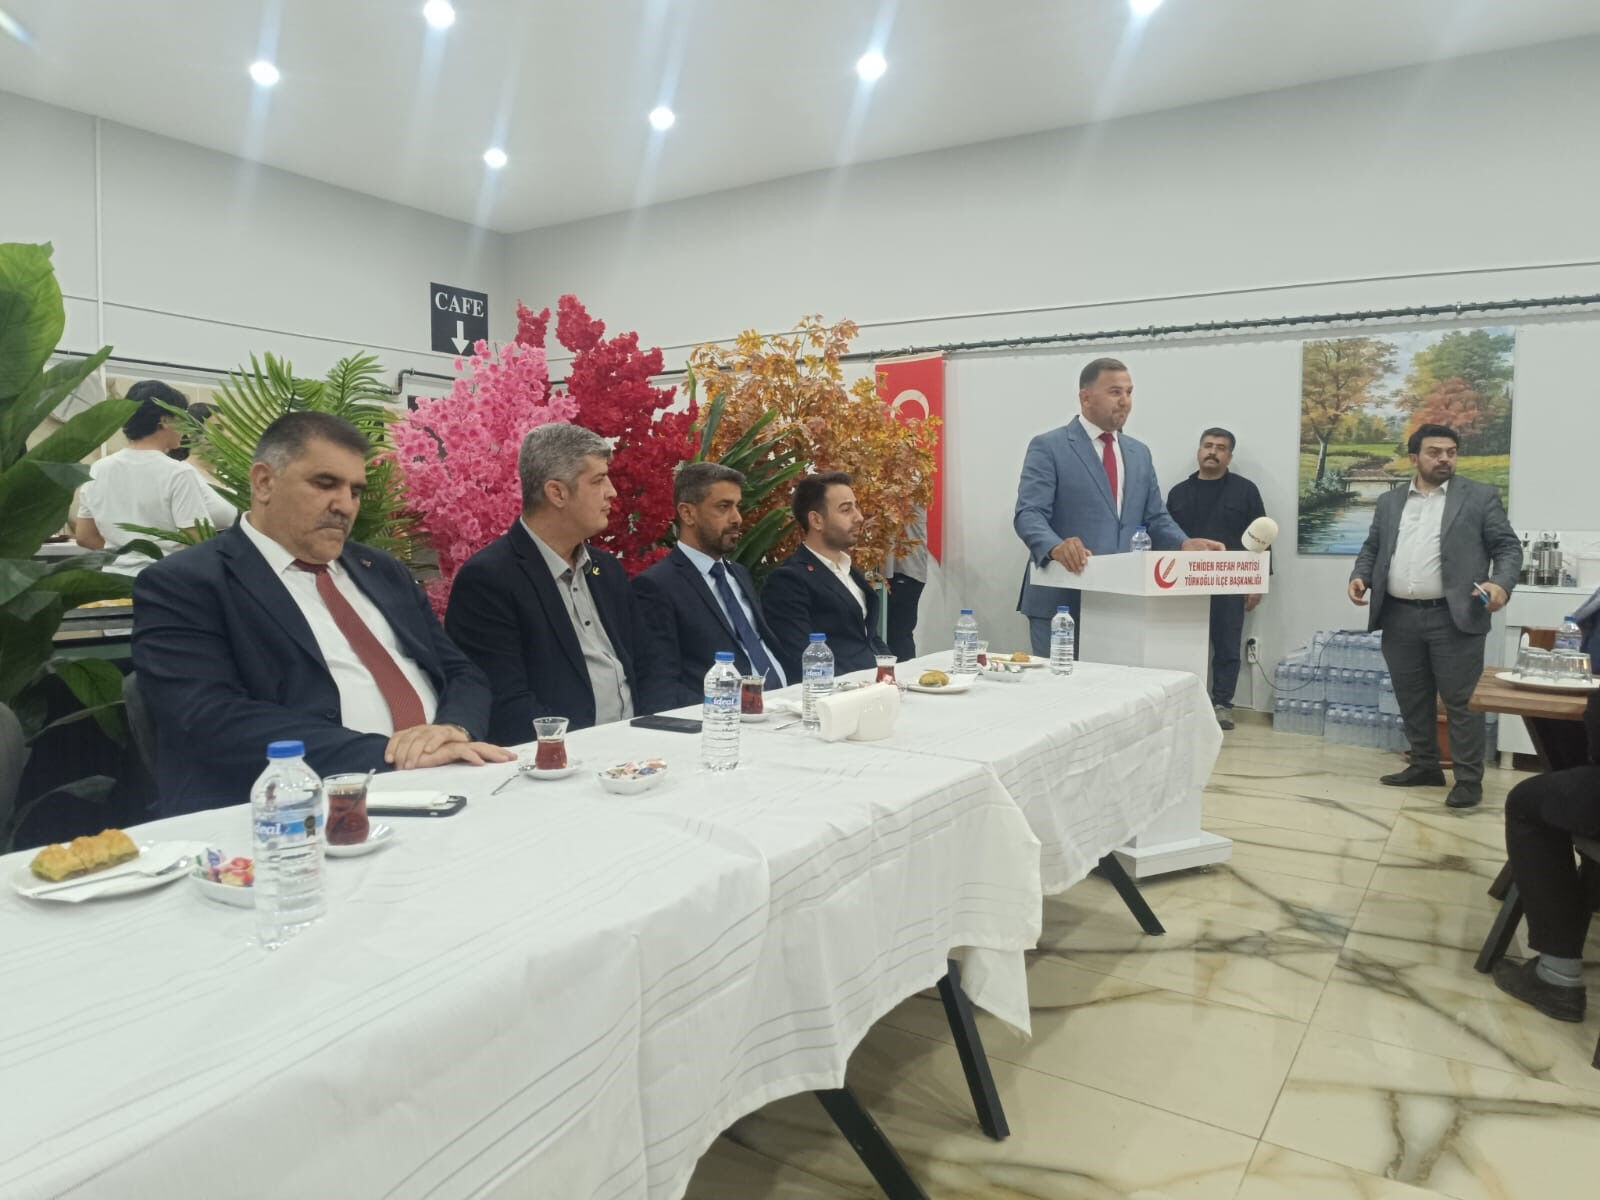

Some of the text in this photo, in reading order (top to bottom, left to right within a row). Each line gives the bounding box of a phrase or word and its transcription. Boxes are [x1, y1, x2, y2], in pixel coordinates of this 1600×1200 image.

[435, 291, 484, 317] CAFE
[1189, 559, 1260, 572] YENİDEN REFAH PARTİSİ
[1184, 574, 1262, 587] TÜRKOĞLU İLÇE BAŞKANLIĞI
[713, 695, 735, 705] ideal
